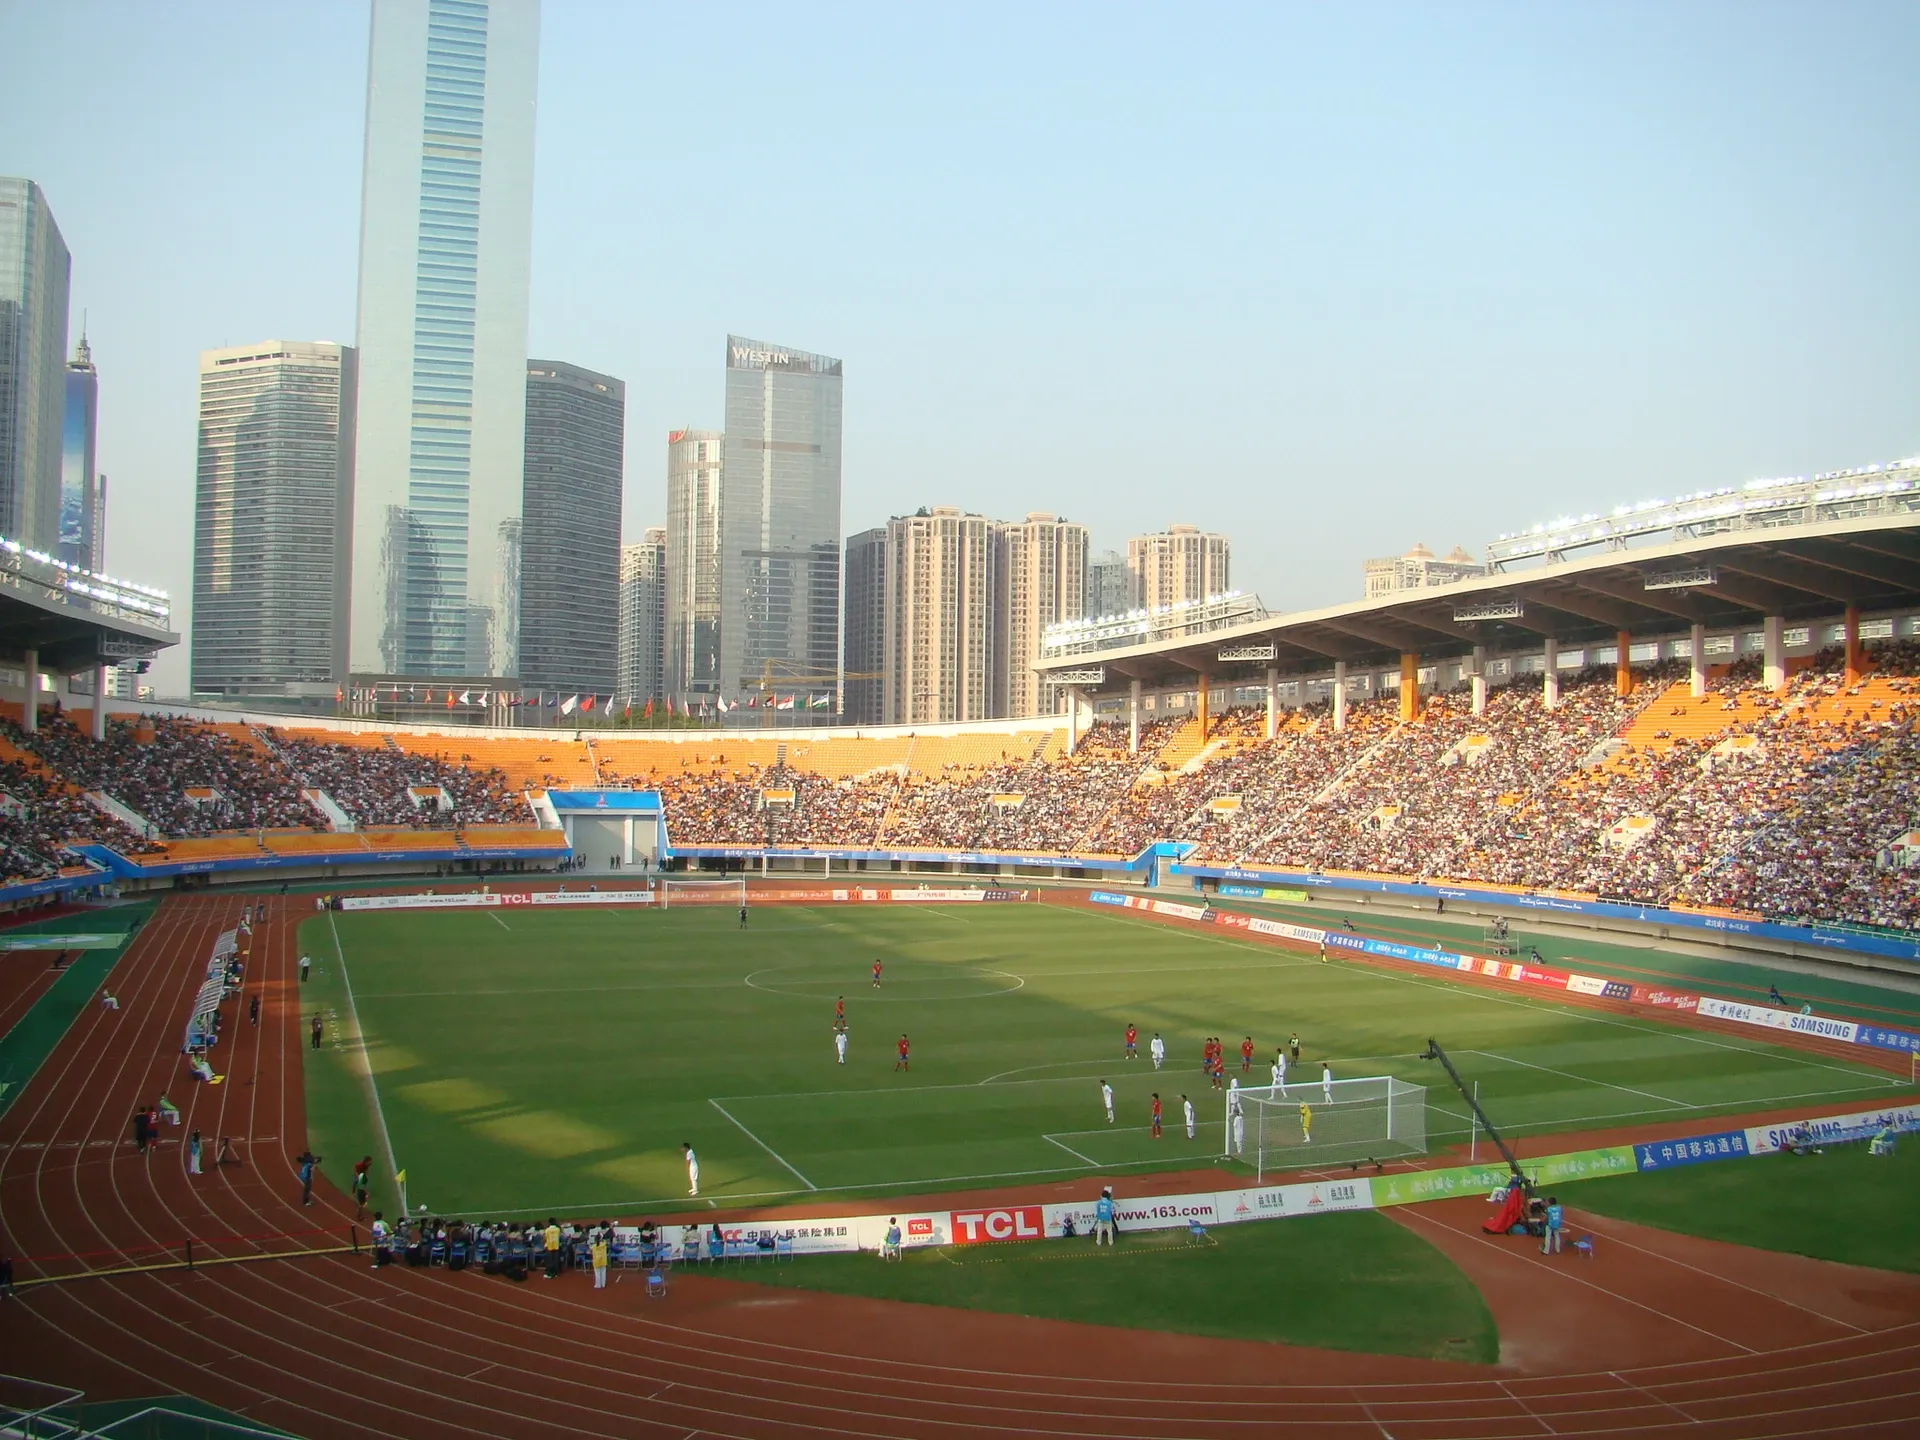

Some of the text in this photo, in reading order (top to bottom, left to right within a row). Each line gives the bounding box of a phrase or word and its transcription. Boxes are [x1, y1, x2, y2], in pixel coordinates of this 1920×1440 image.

[732, 346, 789, 364] WESTIN
[502, 894, 531, 904] TCL
[1293, 928, 1322, 940] SAMSUNG
[1791, 1016, 1850, 1038] SAMSUNG
[1769, 1121, 1841, 1147] SAMUNG
[1661, 1135, 1744, 1162] 中国移动通信
[911, 1223, 929, 1231] TCL
[957, 1211, 1038, 1240] TCL
